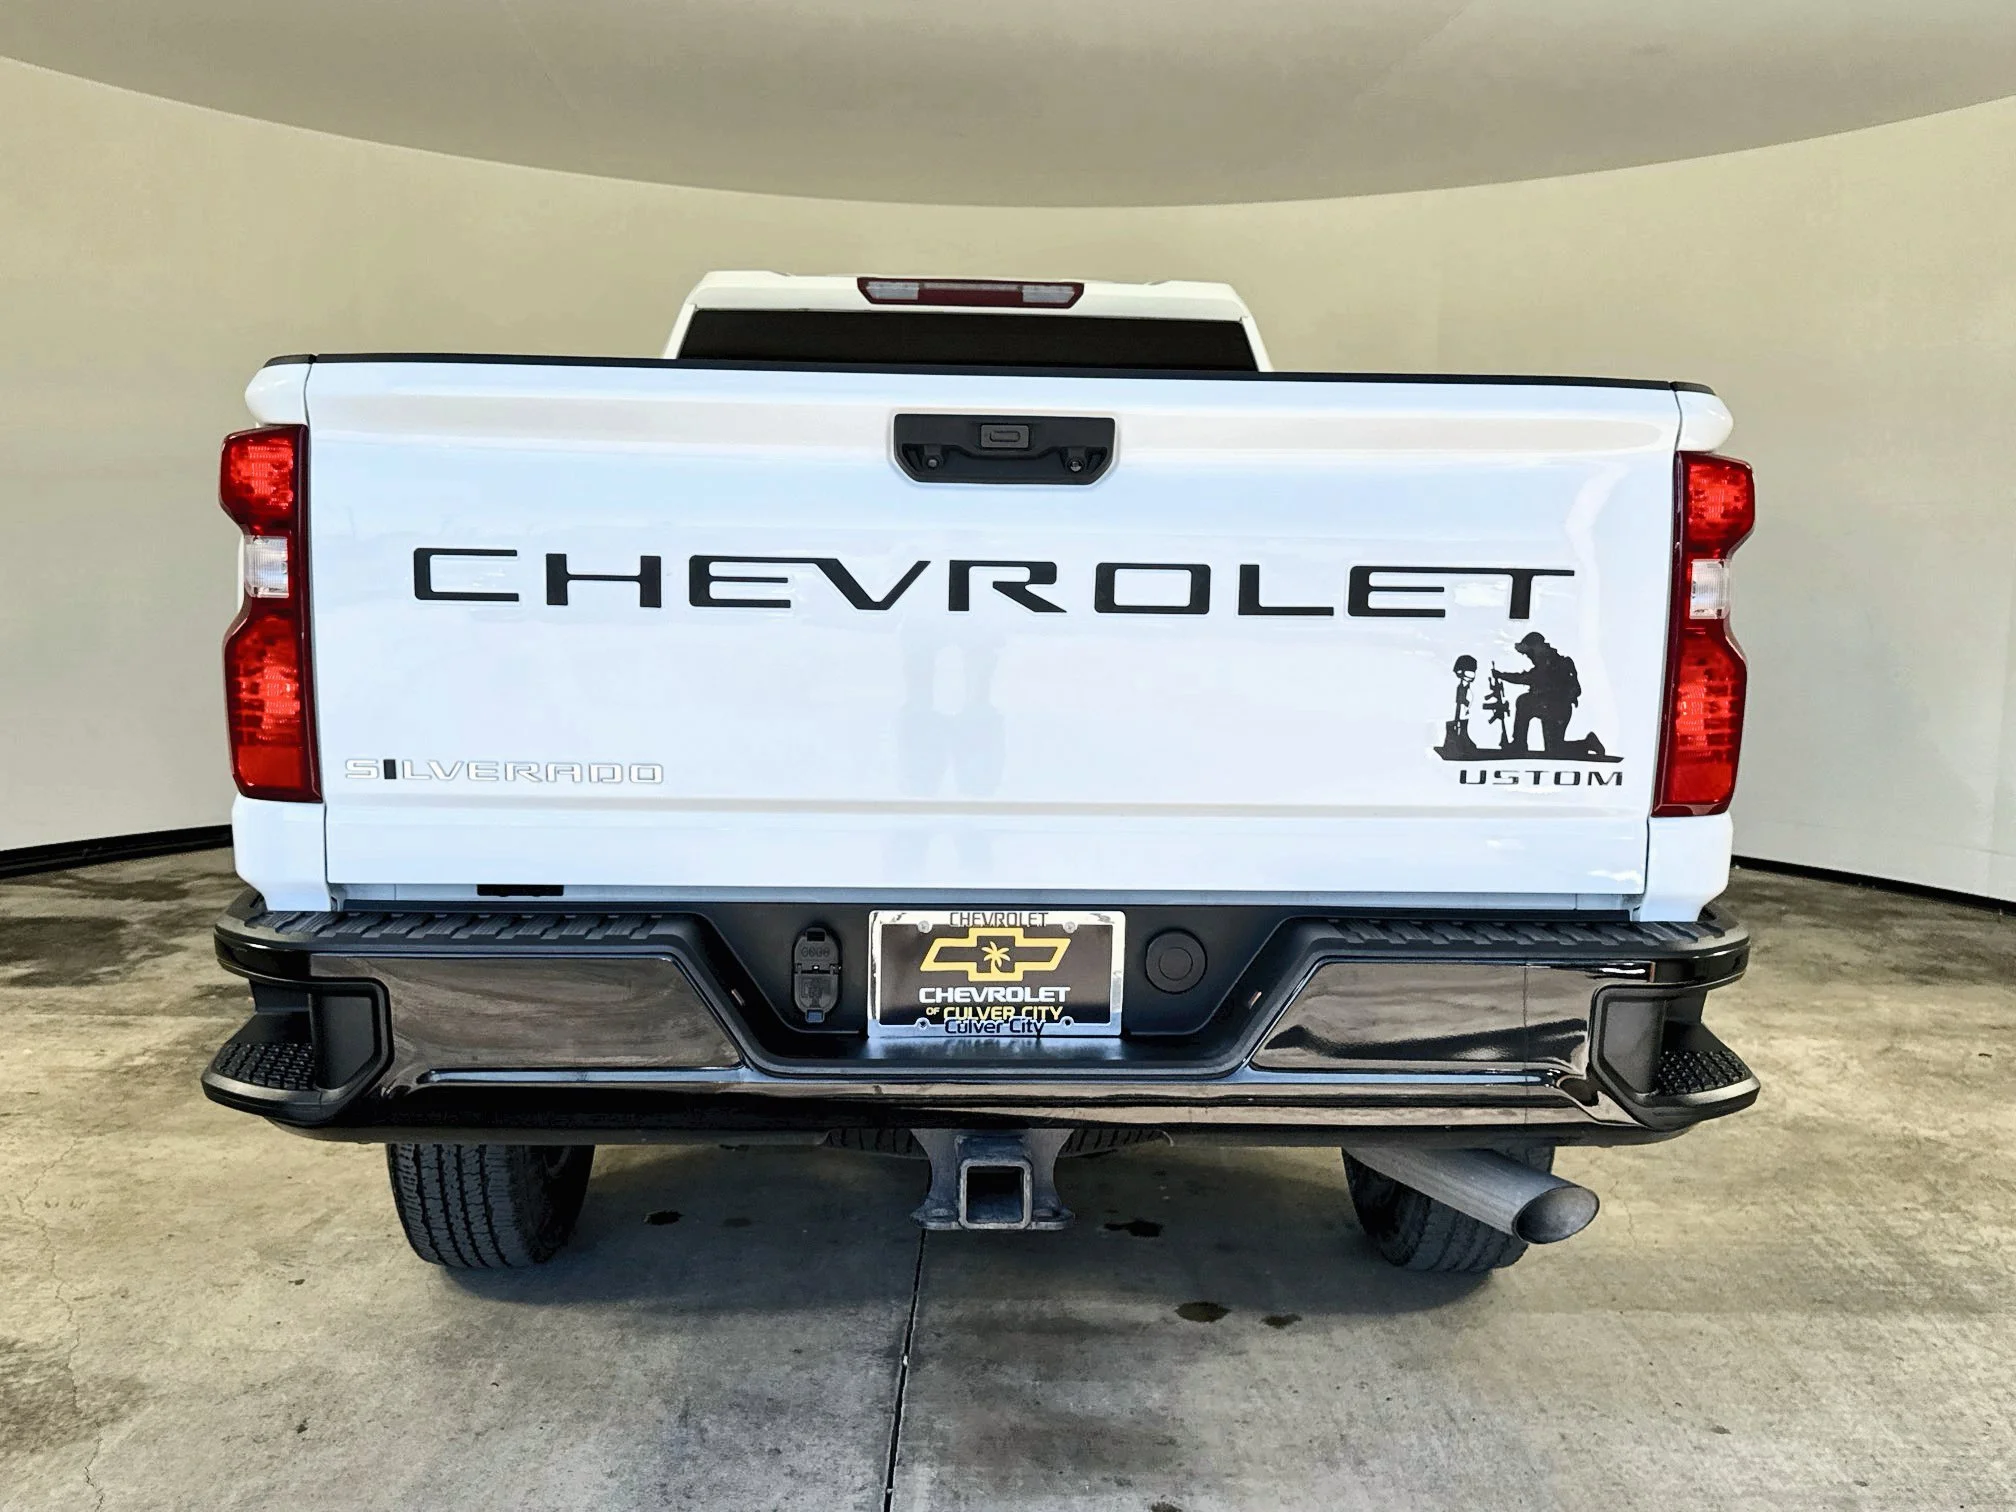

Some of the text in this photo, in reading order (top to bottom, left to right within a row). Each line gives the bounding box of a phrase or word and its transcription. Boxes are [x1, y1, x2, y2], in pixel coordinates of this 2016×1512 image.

[414, 547, 1574, 620] CHEVROLET
[345, 758, 664, 784] SILVERADO
[949, 911, 1049, 927] CHEVROLET
[919, 986, 1071, 1003] CHEVROLET
[925, 1005, 1063, 1020] OF CULVER CITY
[944, 1018, 1045, 1036] Culver City
